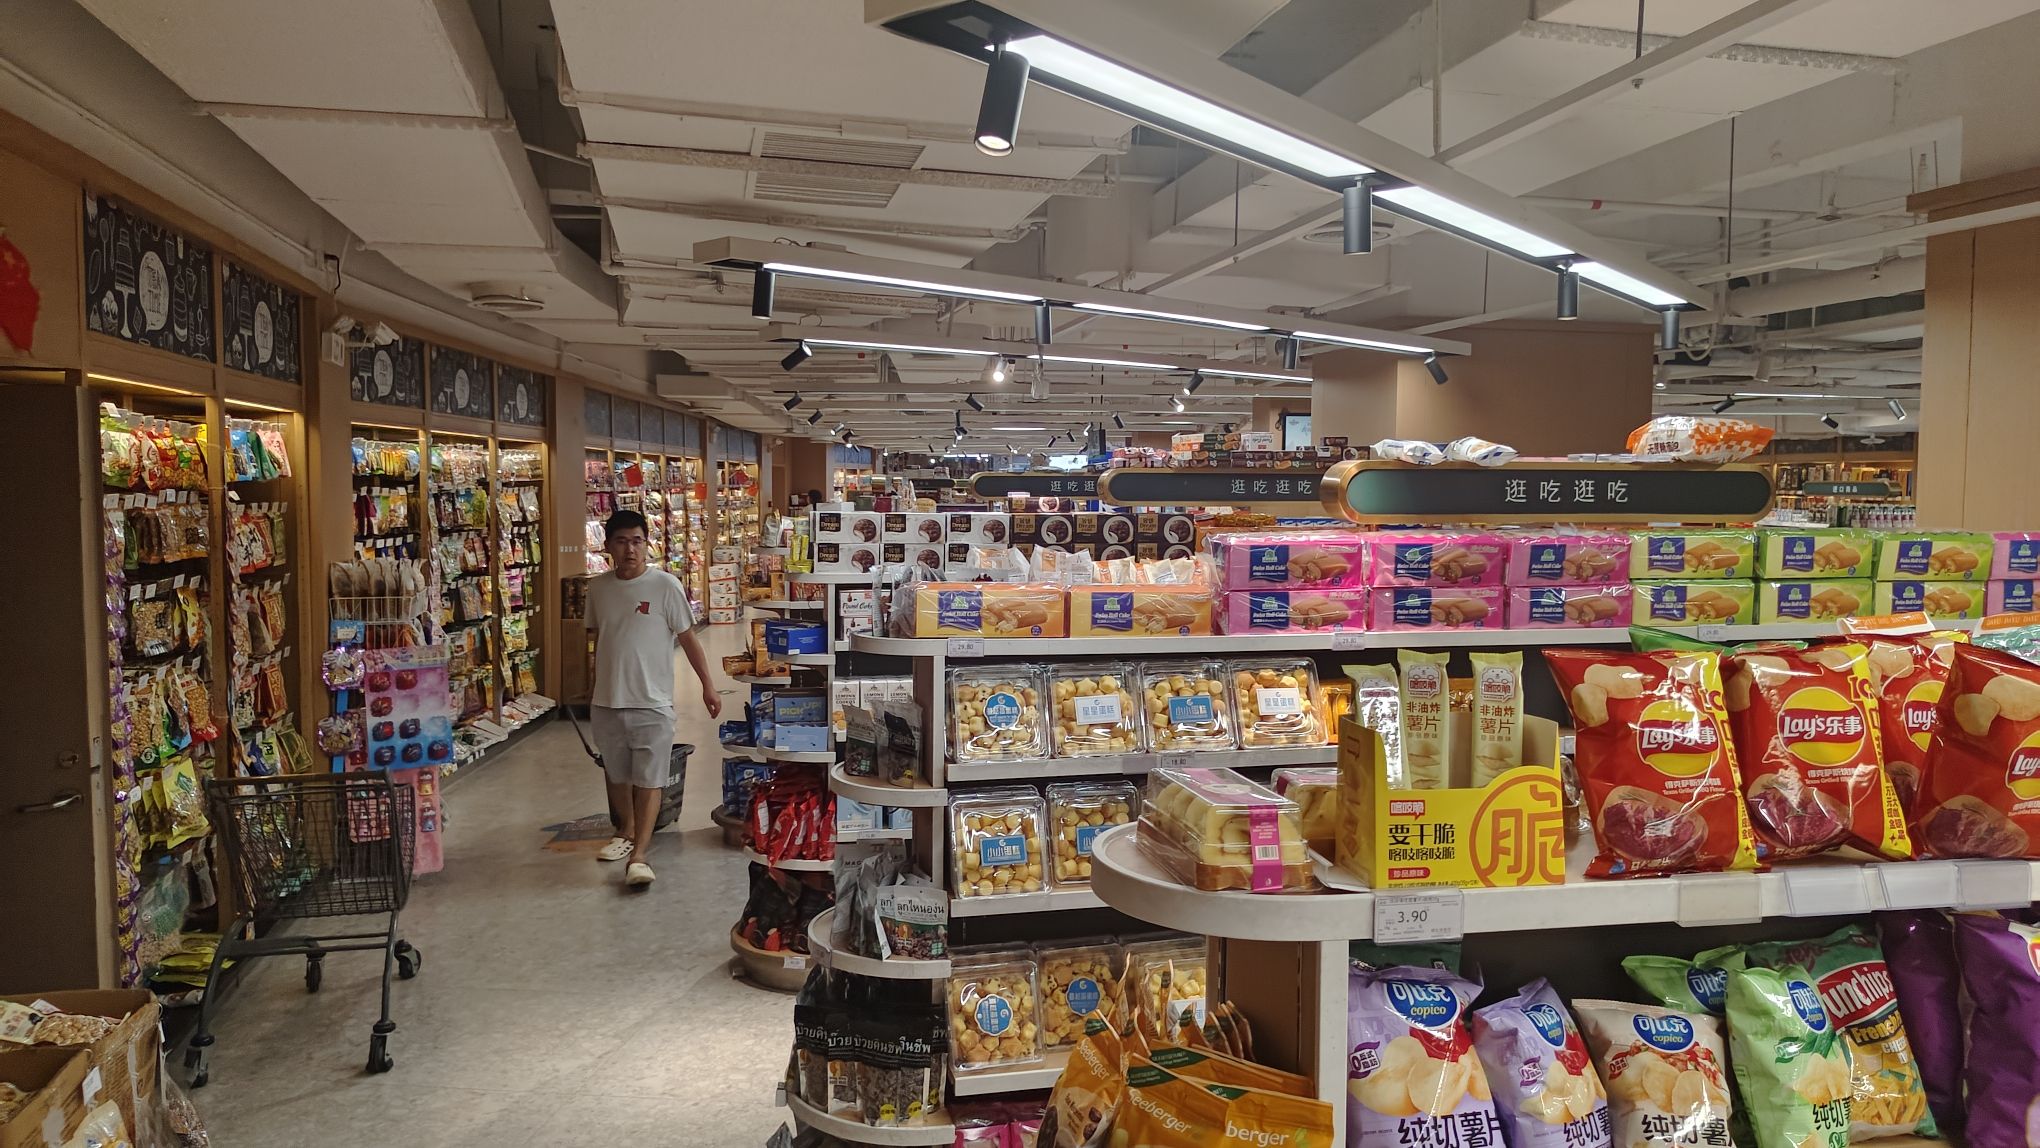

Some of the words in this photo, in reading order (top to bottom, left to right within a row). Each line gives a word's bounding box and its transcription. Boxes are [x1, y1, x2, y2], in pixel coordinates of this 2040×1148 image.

[1231, 479, 1313, 495] 逛吃逛吃
[1504, 479, 1629, 503] 逛吃逛吃
[843, 602, 859, 610] Pound
[1264, 697, 1295, 706] 星星蛋糕
[1406, 701, 1441, 714] 非油炸
[1082, 705, 1116, 716] 星星蛋糕
[1175, 705, 1206, 715] 小小蛋糕
[1479, 705, 1515, 718] 非油炸
[1406, 716, 1441, 732] 薯片
[1480, 718, 1515, 735] 薯片
[1783, 715, 1825, 739] Lay's
[1825, 715, 1864, 735] 乐事
[1642, 727, 1681, 750] Lay's
[1388, 823, 1455, 846] 要干脆
[1388, 847, 1455, 862] 喀吱喀吱脆
[1397, 910, 1428, 924] 3.90
[1393, 982, 1451, 1002] 可比克
[1410, 1004, 1447, 1018] copico
[1638, 1016, 1688, 1036] 可比克
[1652, 1031, 1684, 1044] copico
[1076, 1036, 1110, 1080] Seeberger
[1127, 1087, 1192, 1135] Seeberger
[1224, 1120, 1290, 1148] berger
